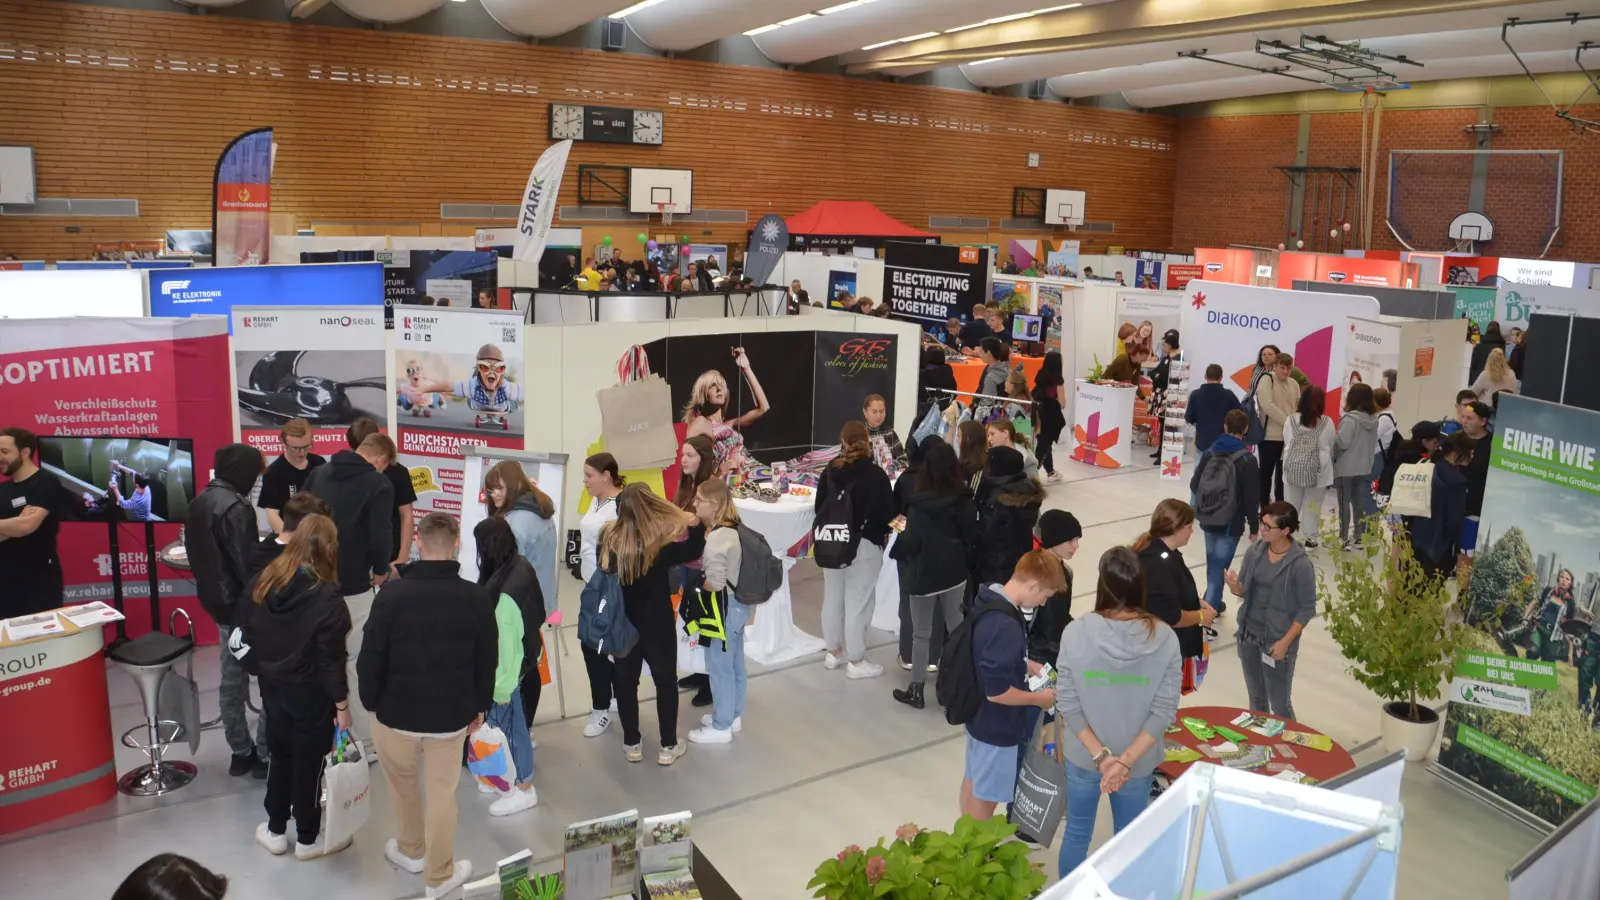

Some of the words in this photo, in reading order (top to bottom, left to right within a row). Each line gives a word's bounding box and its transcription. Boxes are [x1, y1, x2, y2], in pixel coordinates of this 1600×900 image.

[520, 176, 544, 236] STARK
[760, 246, 778, 254] POLIZEI
[1518, 268, 1532, 276] Wir
[1534, 268, 1552, 276] sind
[893, 272, 970, 292] ELECTRIFYING
[182, 290, 222, 299] ELEKTRONIK
[387, 288, 416, 296] STARTS
[892, 284, 912, 298] THE
[914, 288, 957, 304] FUTURE
[892, 298, 948, 318] TOGETHER
[0, 351, 154, 386] OPTIMIERT
[824, 354, 846, 368] colors
[54, 397, 157, 410] Verschleißschutz
[34, 410, 158, 424] Wasserkraftanlagen
[54, 423, 158, 436] Abwassertechnik
[404, 432, 488, 448] DURCHSTARTEN
[404, 443, 424, 452] DEINE
[1502, 428, 1554, 460] EINER
[1560, 440, 1596, 472] WIE
[1400, 473, 1428, 482] STARK
[1500, 458, 1519, 471] bringt
[1520, 463, 1548, 478] Ordnung
[1548, 470, 1555, 478] in
[1556, 472, 1568, 483] den
[814, 524, 850, 542] VANS
[120, 564, 148, 575] GMB
[1486, 656, 1506, 668] DEINE
[1510, 660, 1554, 676] AUSBILDUNG
[1487, 669, 1498, 678] BEI
[1500, 670, 1515, 681] UNS
[8, 760, 58, 780] REHART
[8, 772, 45, 789] GMBH
